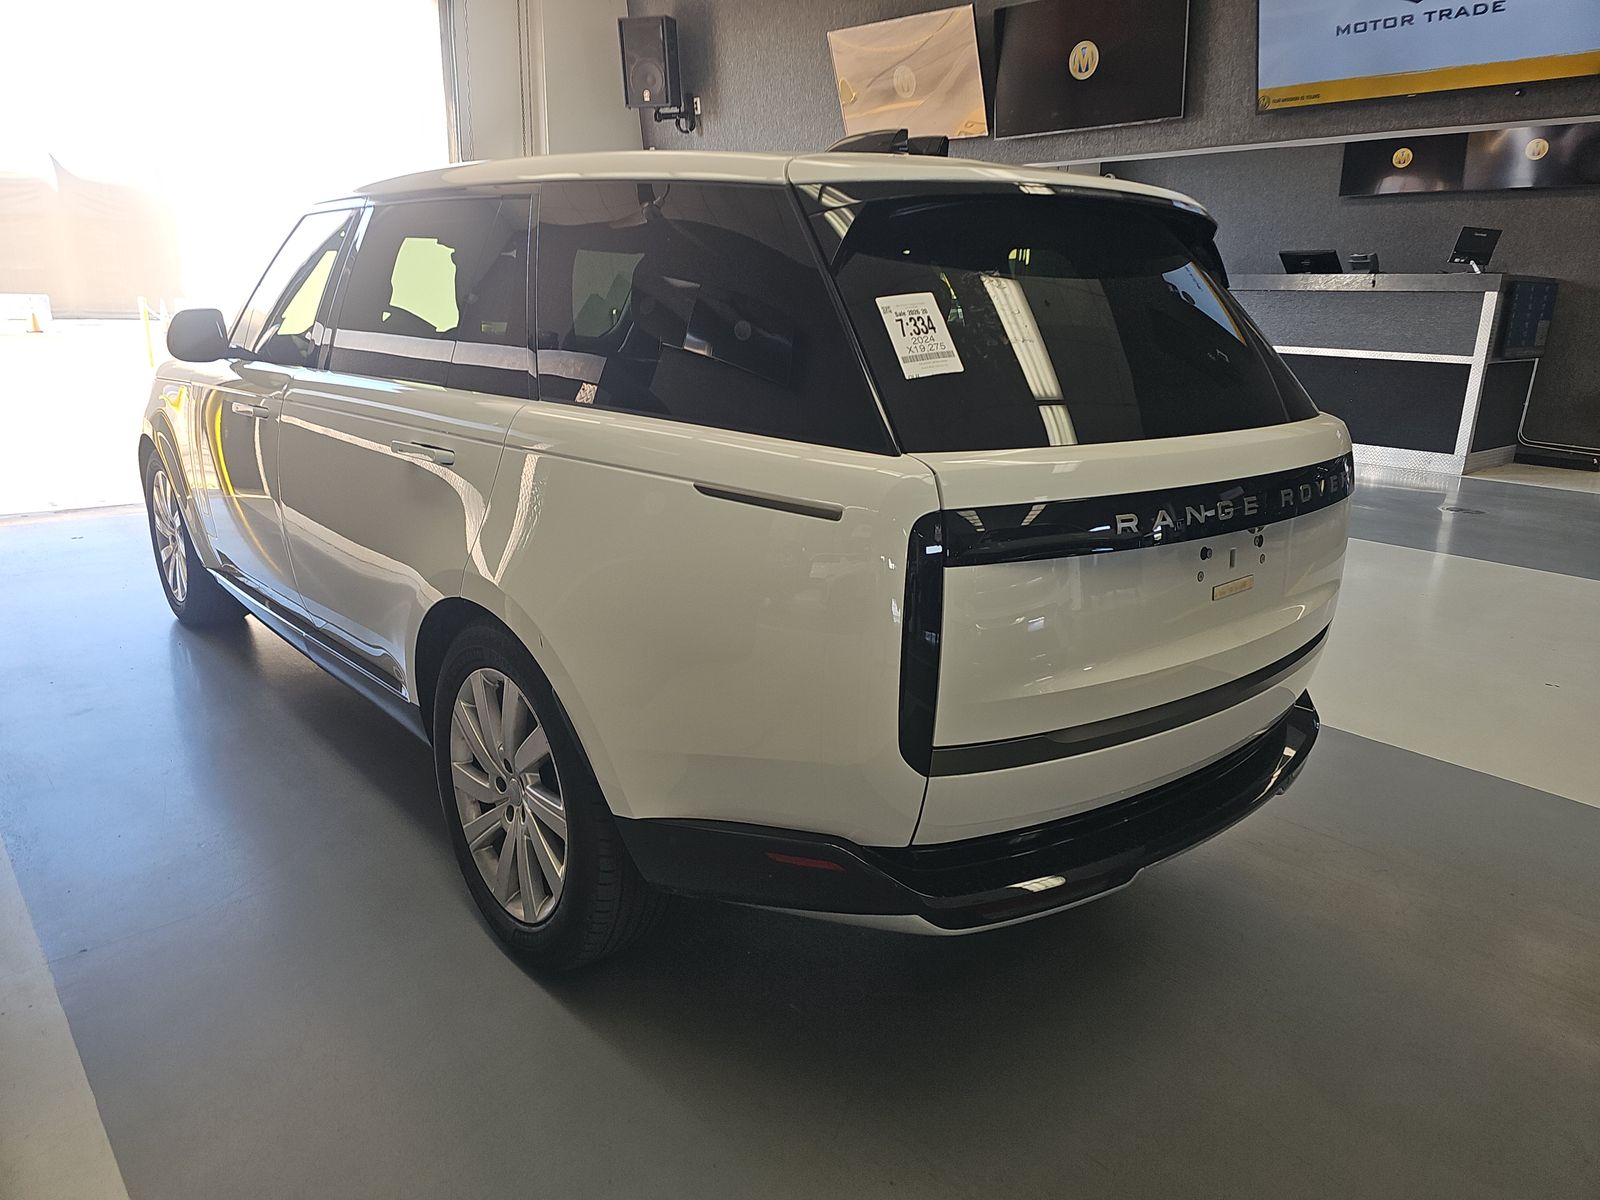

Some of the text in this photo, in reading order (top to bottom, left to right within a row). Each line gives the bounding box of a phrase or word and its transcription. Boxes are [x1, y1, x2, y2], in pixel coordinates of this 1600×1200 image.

[1336, 0, 1506, 36] MOTOR TRADE
[895, 315, 937, 337] 7:334
[911, 335, 935, 345] 2024
[1115, 496, 1259, 535] RANGE
